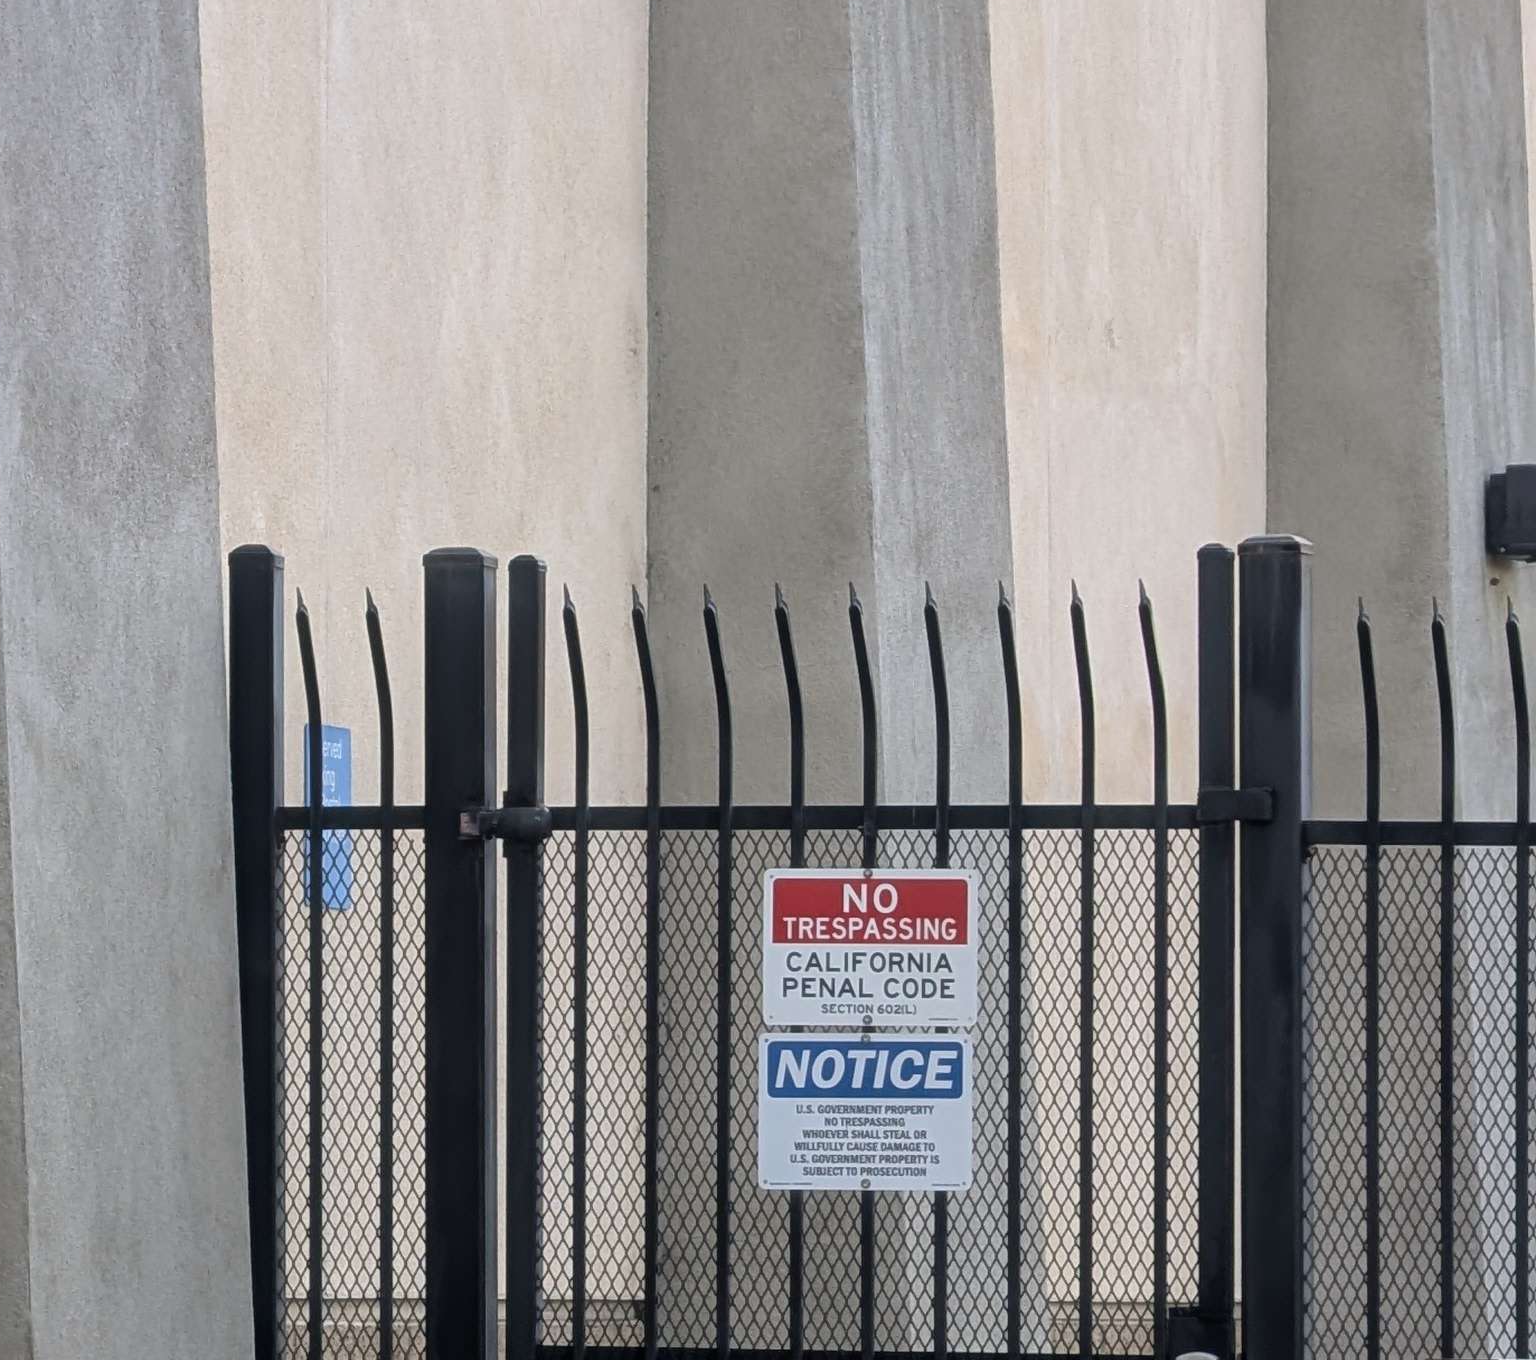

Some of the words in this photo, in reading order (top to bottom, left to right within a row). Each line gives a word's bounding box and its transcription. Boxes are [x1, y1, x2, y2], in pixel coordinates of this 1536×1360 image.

[843, 883, 898, 913] NO
[783, 917, 957, 940] TRESPASSING
[786, 952, 952, 973] CALIFORNIA
[783, 978, 873, 998] PENAL
[884, 978, 955, 999] CODE
[821, 1004, 873, 1014] SECTION
[775, 1049, 958, 1089] NOTICE
[796, 1105, 814, 1114] U.S.
[818, 1105, 882, 1114] GOVERNMENT
[885, 1105, 934, 1114] PROPERTY
[824, 1118, 838, 1126] NO
[841, 1118, 905, 1127] TRESPASSING
[802, 1130, 848, 1139] WHOEVER
[851, 1130, 880, 1139] SHALL
[883, 1130, 911, 1139] STEAL
[914, 1130, 927, 1139] OR
[794, 1142, 845, 1151] WILLFULLY
[846, 1142, 878, 1151] CAUSE
[881, 1142, 921, 1151] DAMAGE
[923, 1142, 935, 1152] TO
[790, 1154, 809, 1164] U.S.
[812, 1155, 876, 1164] GOVERNMENT
[878, 1155, 928, 1164] PROPERTY
[930, 1155, 940, 1164] IS
[802, 1167, 844, 1176] SUBJECT
[846, 1167, 857, 1176] TO
[860, 1167, 926, 1176] PROSECUTION
